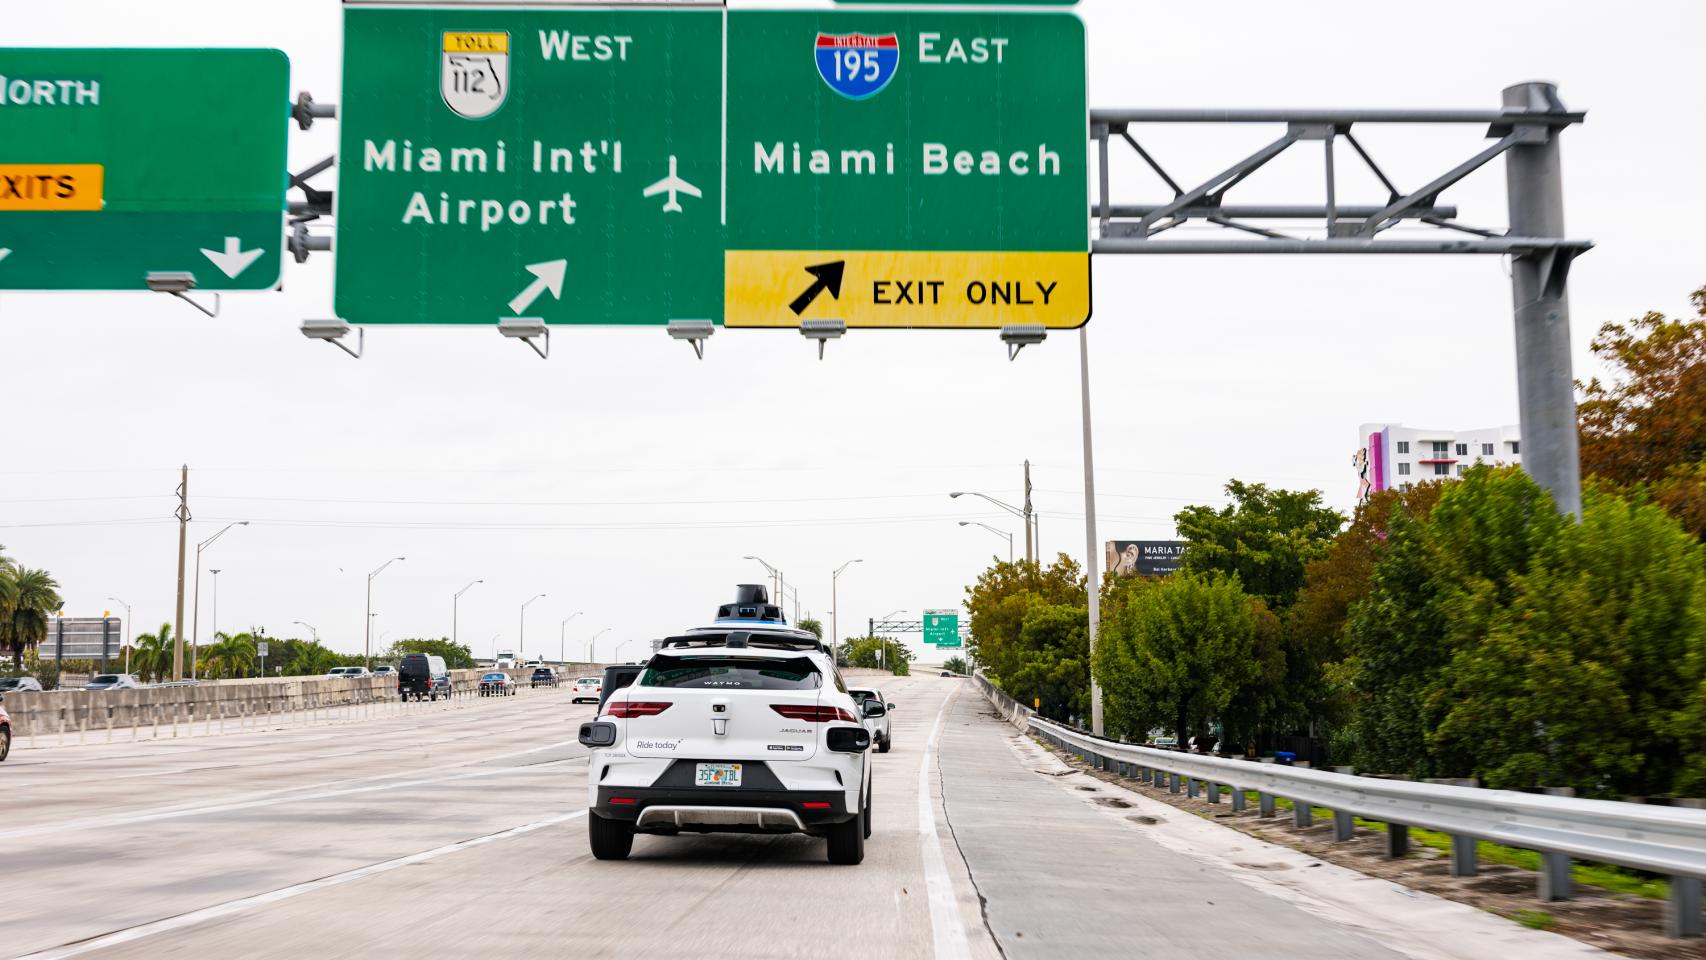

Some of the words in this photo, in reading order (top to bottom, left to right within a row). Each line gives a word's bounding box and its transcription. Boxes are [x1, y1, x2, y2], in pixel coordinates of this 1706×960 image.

[455, 34, 497, 49] TOLL
[538, 29, 633, 61] WEST
[833, 36, 880, 49] INTERSTATE
[918, 31, 1009, 63] EAST
[833, 48, 880, 82] 195
[454, 68, 485, 94] 112
[363, 139, 506, 173] Miami
[533, 139, 622, 174] Int'l
[753, 141, 894, 175] Miami
[922, 142, 1060, 176] Beach
[0, 174, 77, 200] XITS
[401, 191, 577, 232] Airport
[873, 280, 944, 305] EXIT
[966, 280, 1058, 305] ONLY
[1144, 546, 1173, 555] MARIA
[636, 741, 654, 749] Ride
[655, 741, 678, 751] today
